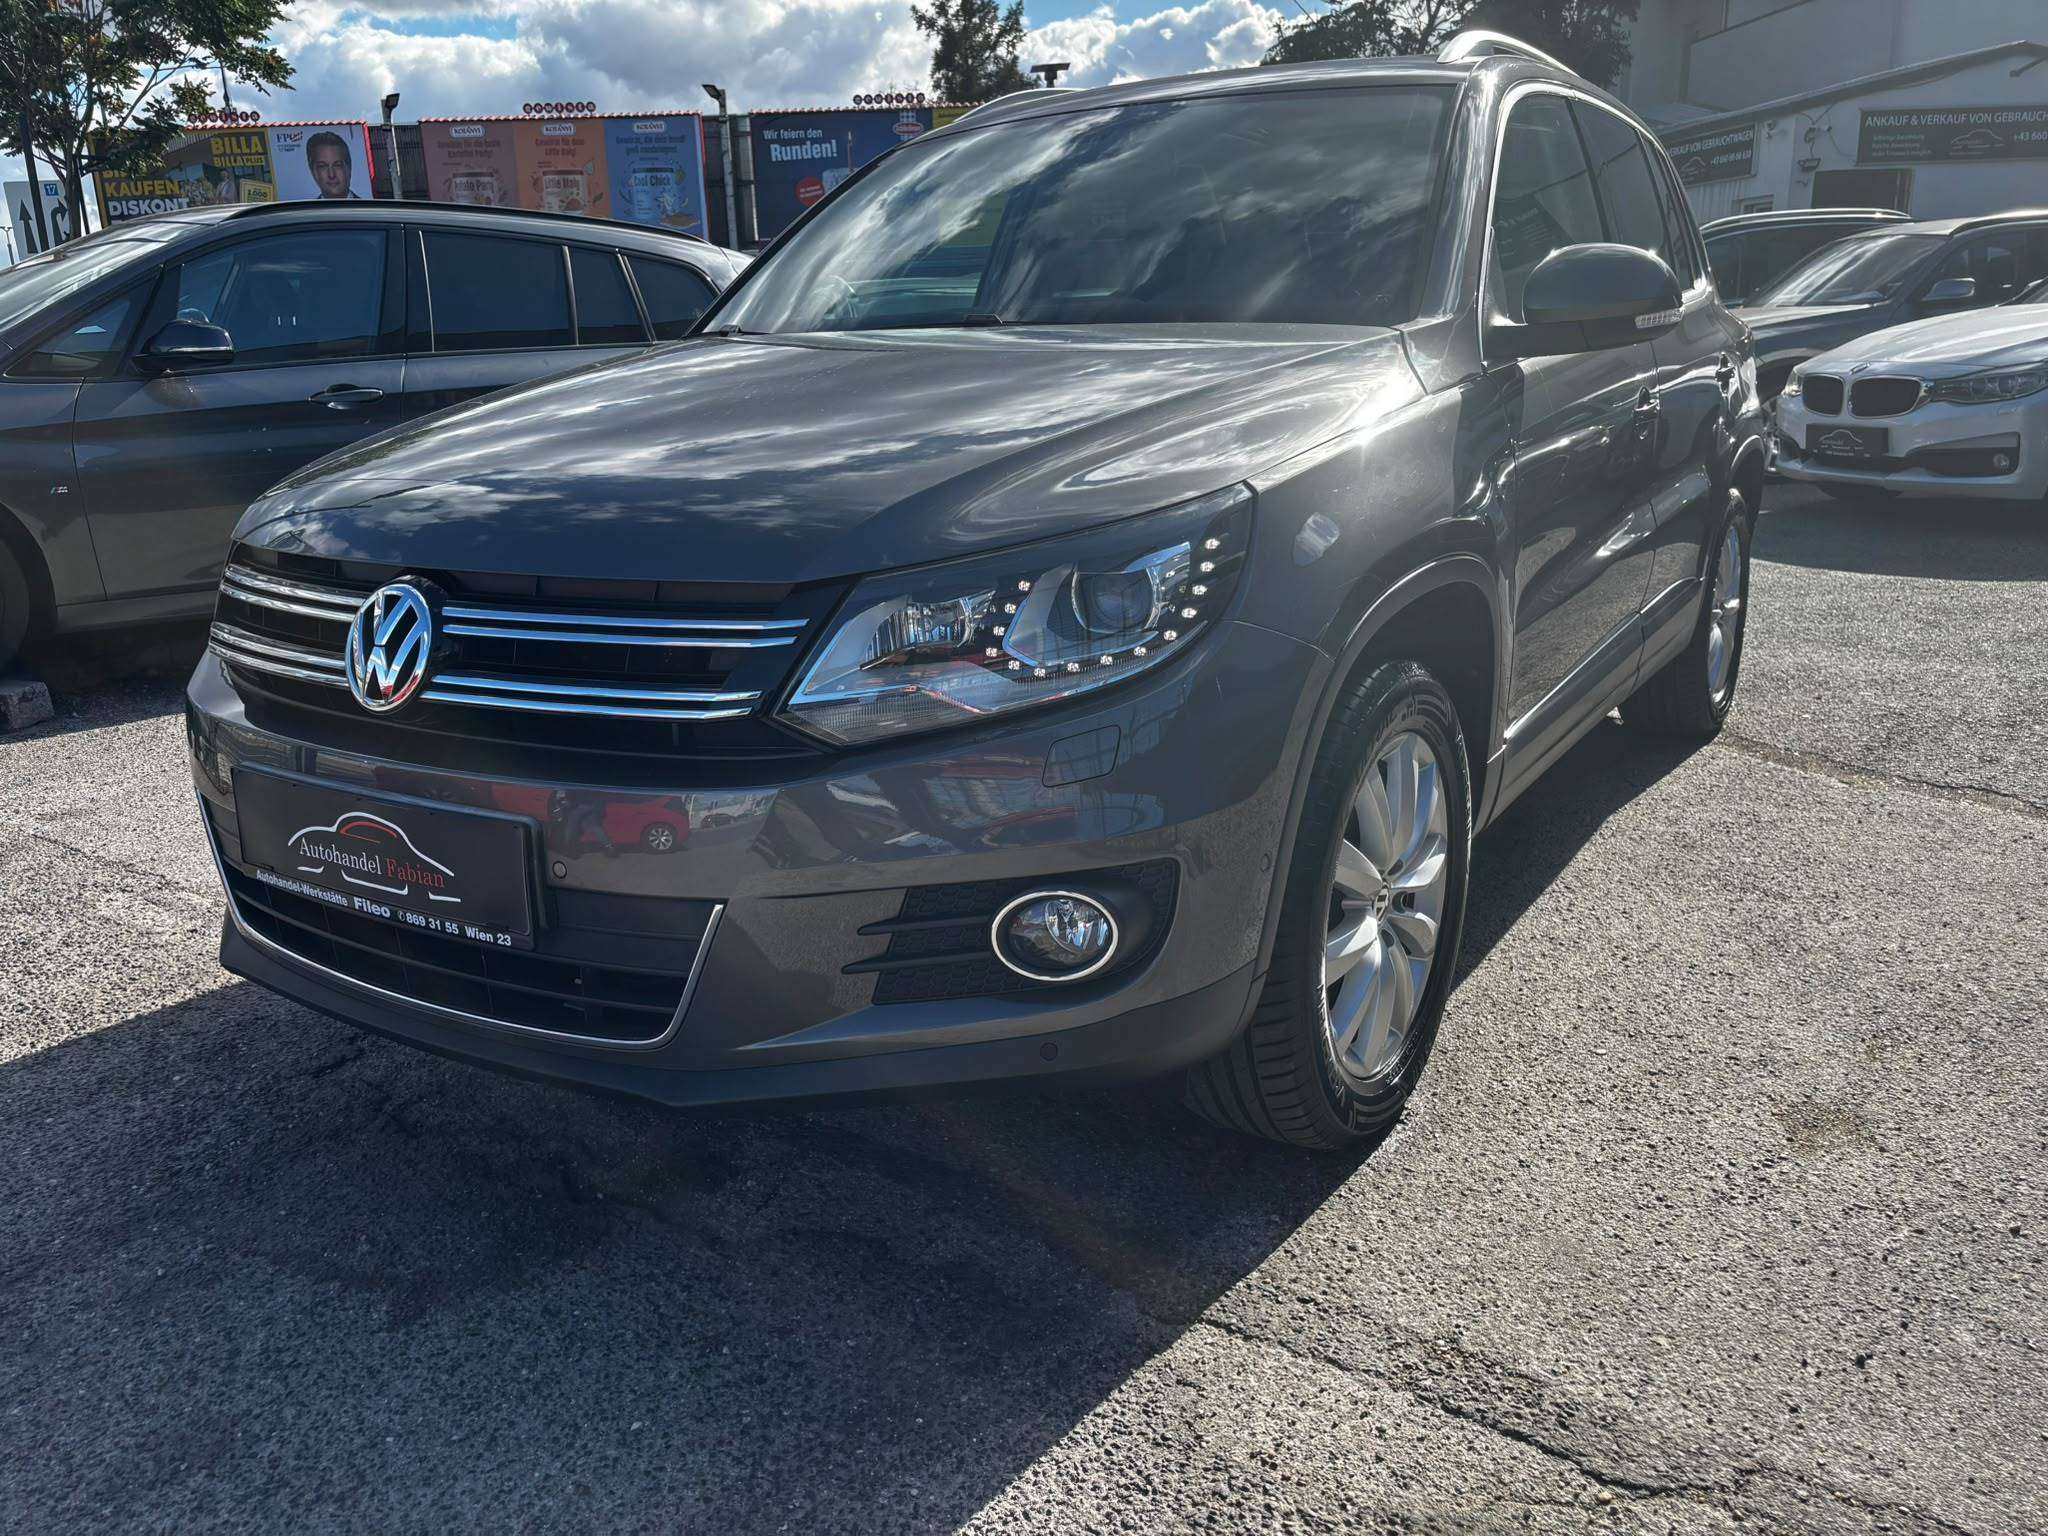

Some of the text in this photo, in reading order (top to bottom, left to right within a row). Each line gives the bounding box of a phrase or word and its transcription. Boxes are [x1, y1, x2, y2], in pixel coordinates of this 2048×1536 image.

[1865, 115, 1910, 128] ANKAUF
[1911, 115, 1919, 126] &
[1920, 113, 1968, 126] VERKAUF
[1969, 112, 1992, 124] VON
[210, 134, 265, 154] BILLA
[763, 129, 823, 140] Wir feiern den
[770, 139, 838, 162] Runden!
[109, 198, 189, 216] DISKONT
[300, 836, 445, 889] Autohandel Fabian
[257, 869, 349, 907] Autohandel-Werkstätte
[353, 896, 391, 919] Fileo
[428, 917, 442, 931] 31
[445, 922, 460, 936] 55
[464, 925, 494, 944] Wien
[497, 933, 512, 947] 23
